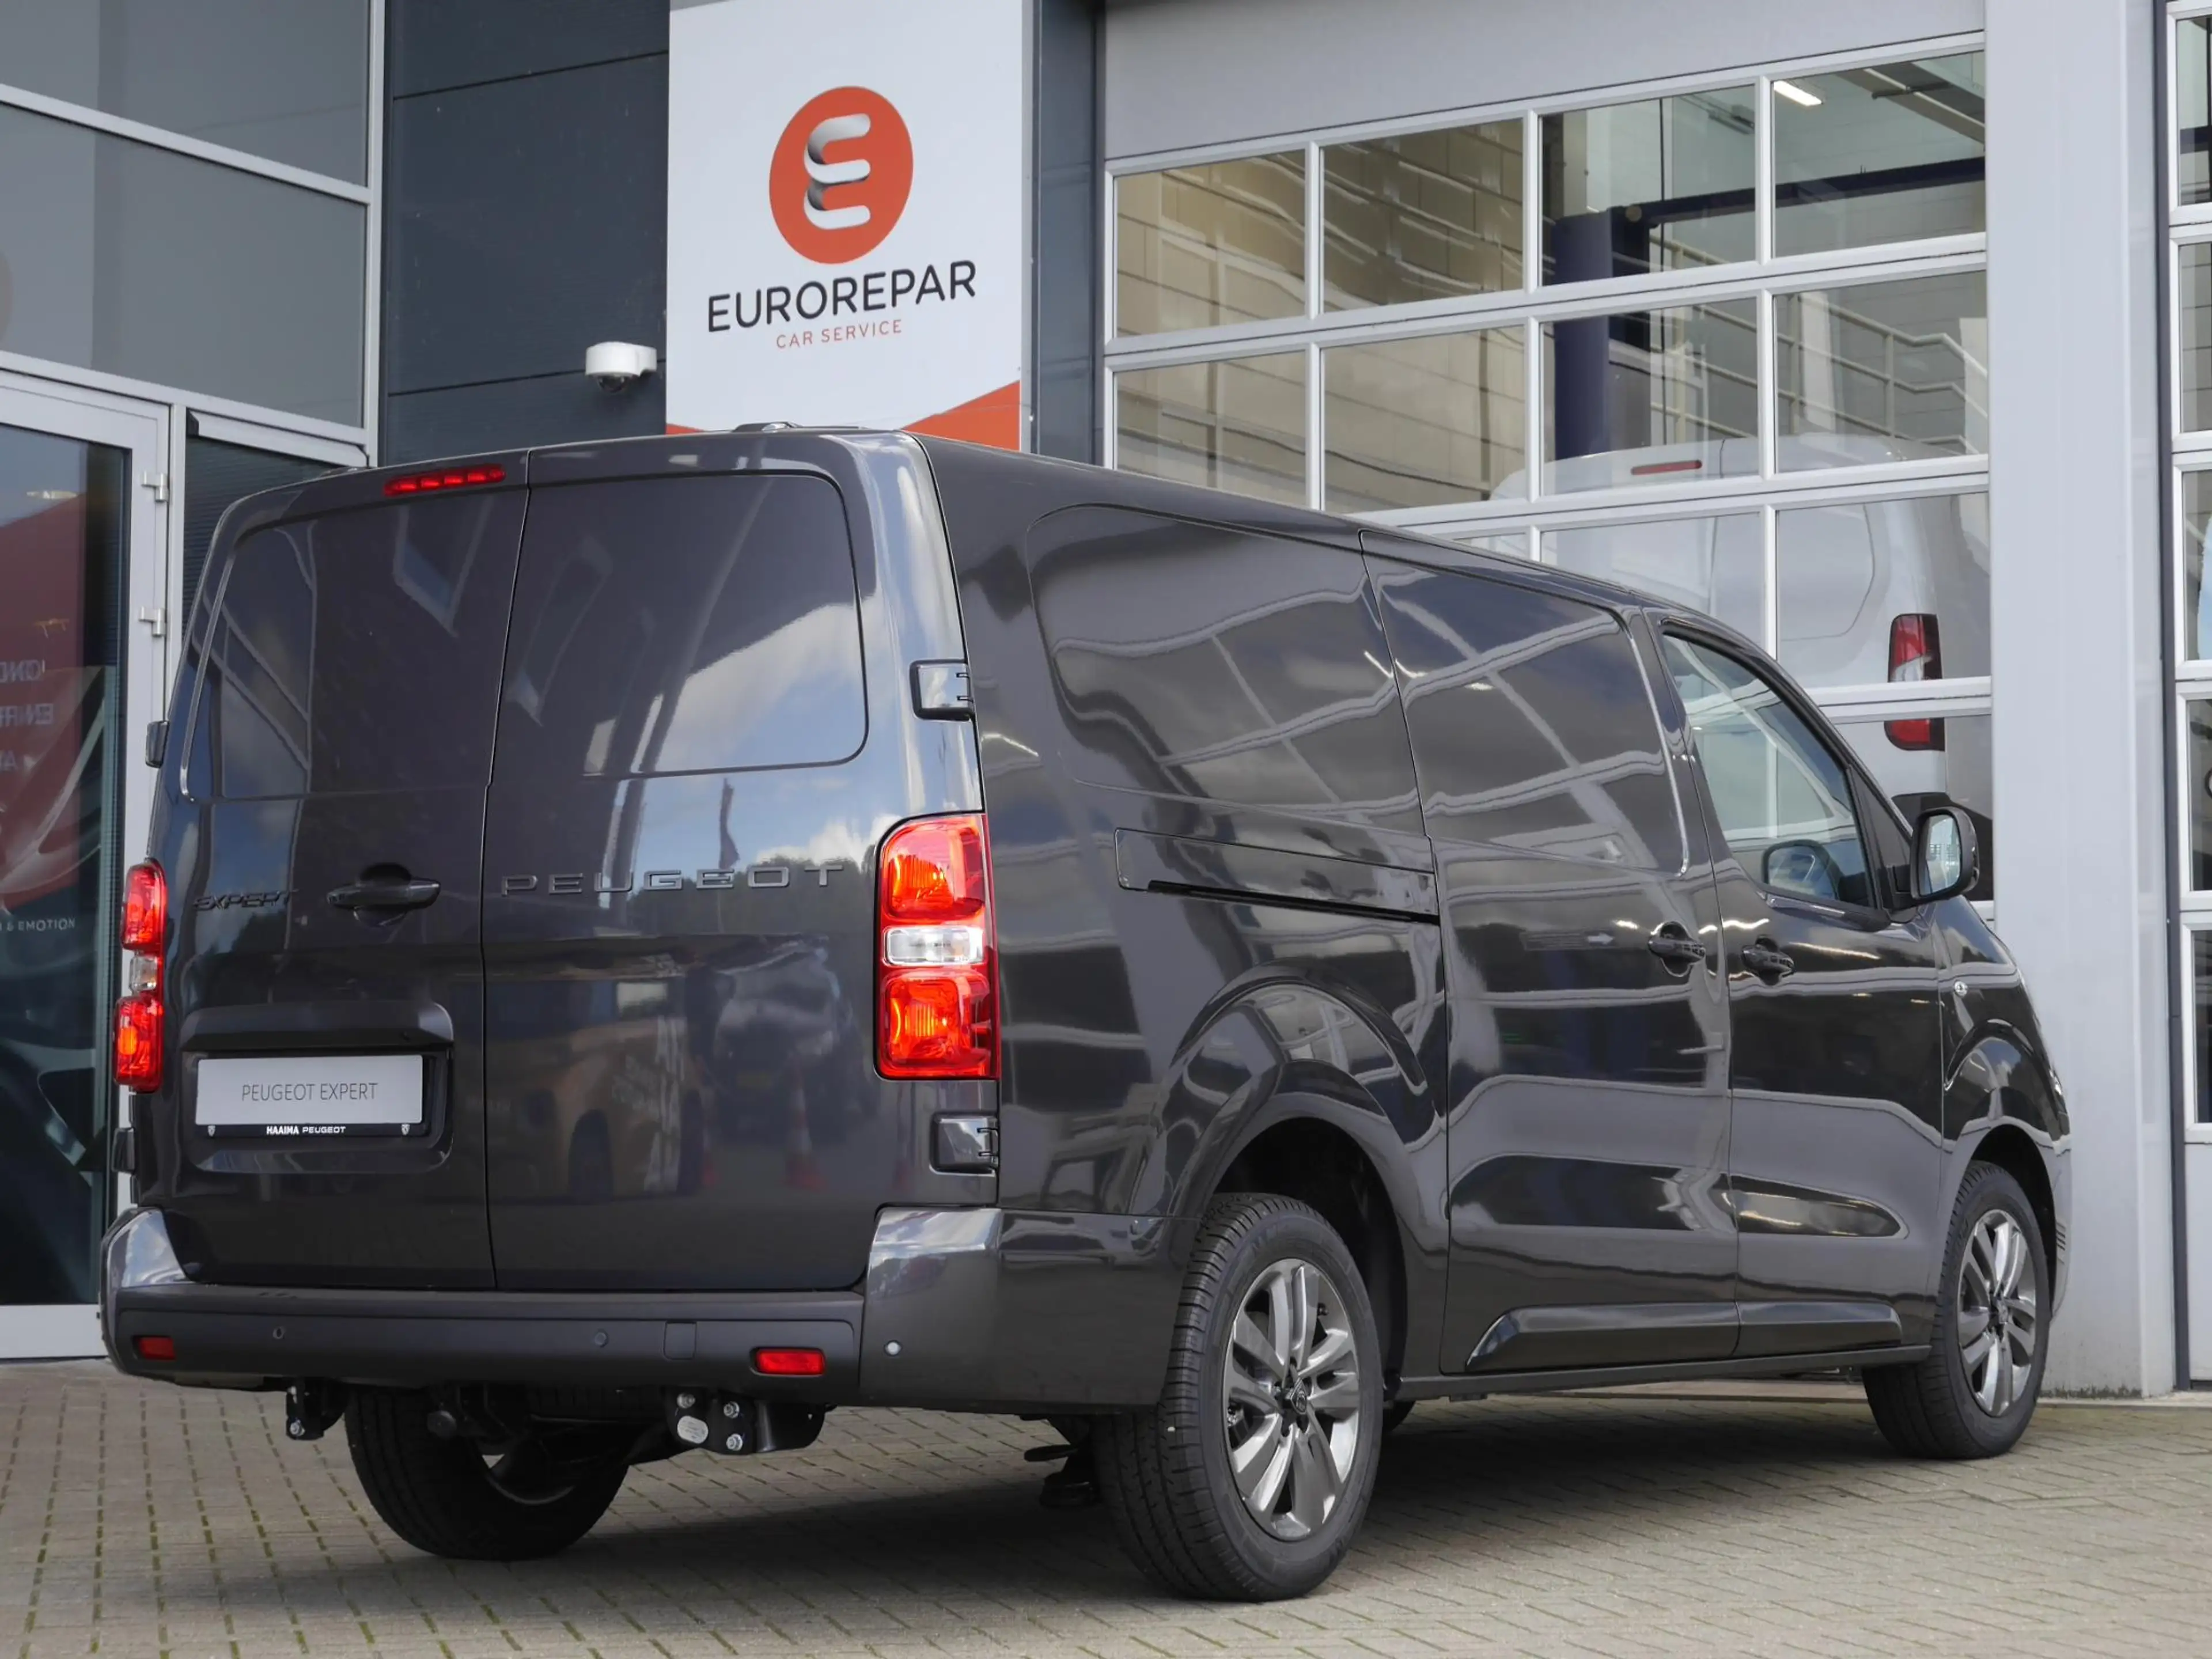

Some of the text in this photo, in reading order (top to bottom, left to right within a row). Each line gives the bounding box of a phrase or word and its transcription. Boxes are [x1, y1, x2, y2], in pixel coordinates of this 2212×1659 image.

[709, 260, 976, 332] EUROREPAR
[776, 319, 903, 349] CAR SERVICE
[501, 865, 844, 896] PEUGEOT
[192, 889, 300, 911] EXPERT
[18, 917, 75, 931] EMOTION
[241, 1083, 378, 1101] PEUGEOT EXPERT
[266, 1124, 346, 1135] HAAIMA PEUGEOT
